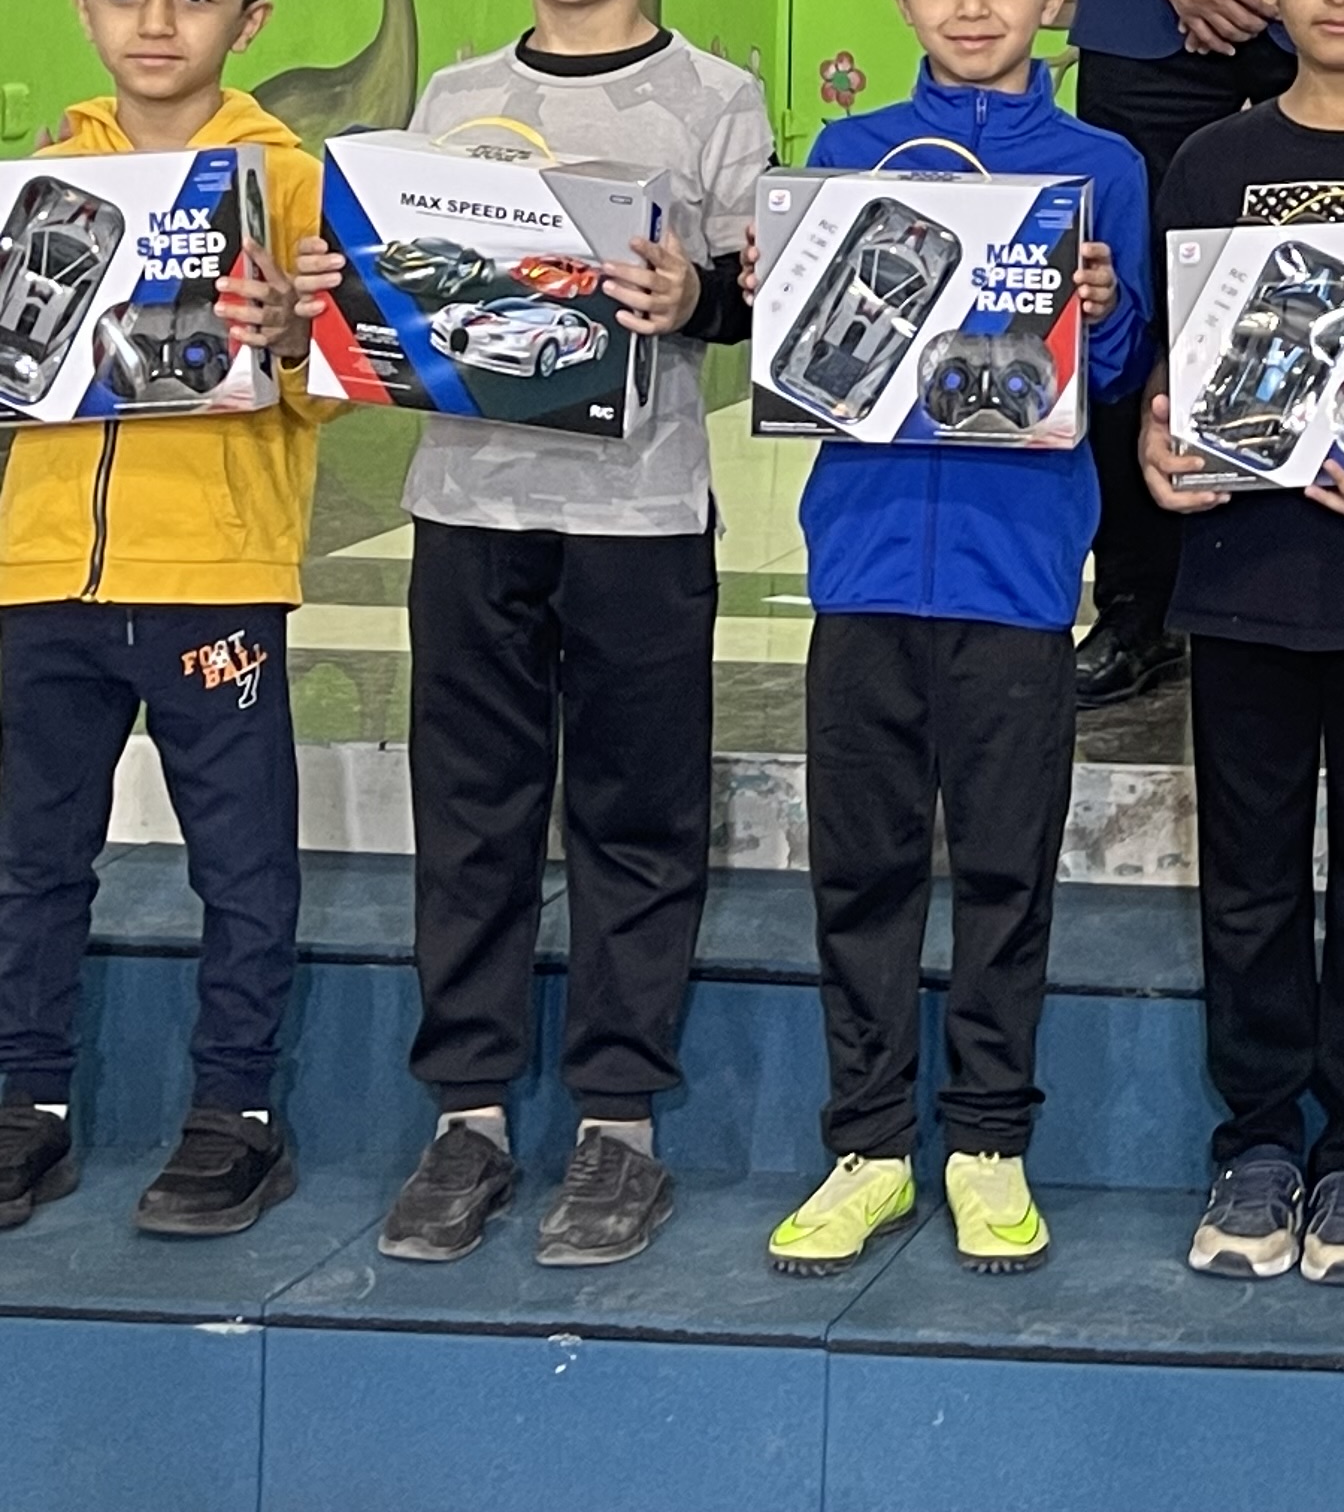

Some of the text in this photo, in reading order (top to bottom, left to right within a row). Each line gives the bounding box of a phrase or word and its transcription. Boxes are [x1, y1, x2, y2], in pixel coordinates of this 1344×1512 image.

[149, 208, 212, 233] MAX
[400, 192, 563, 229] MAX SPEED RACE
[136, 231, 227, 256] SPEED
[986, 243, 1048, 266] MAX
[143, 255, 221, 281] RACE
[971, 267, 1062, 290] SPEED
[976, 290, 1054, 315] RACE
